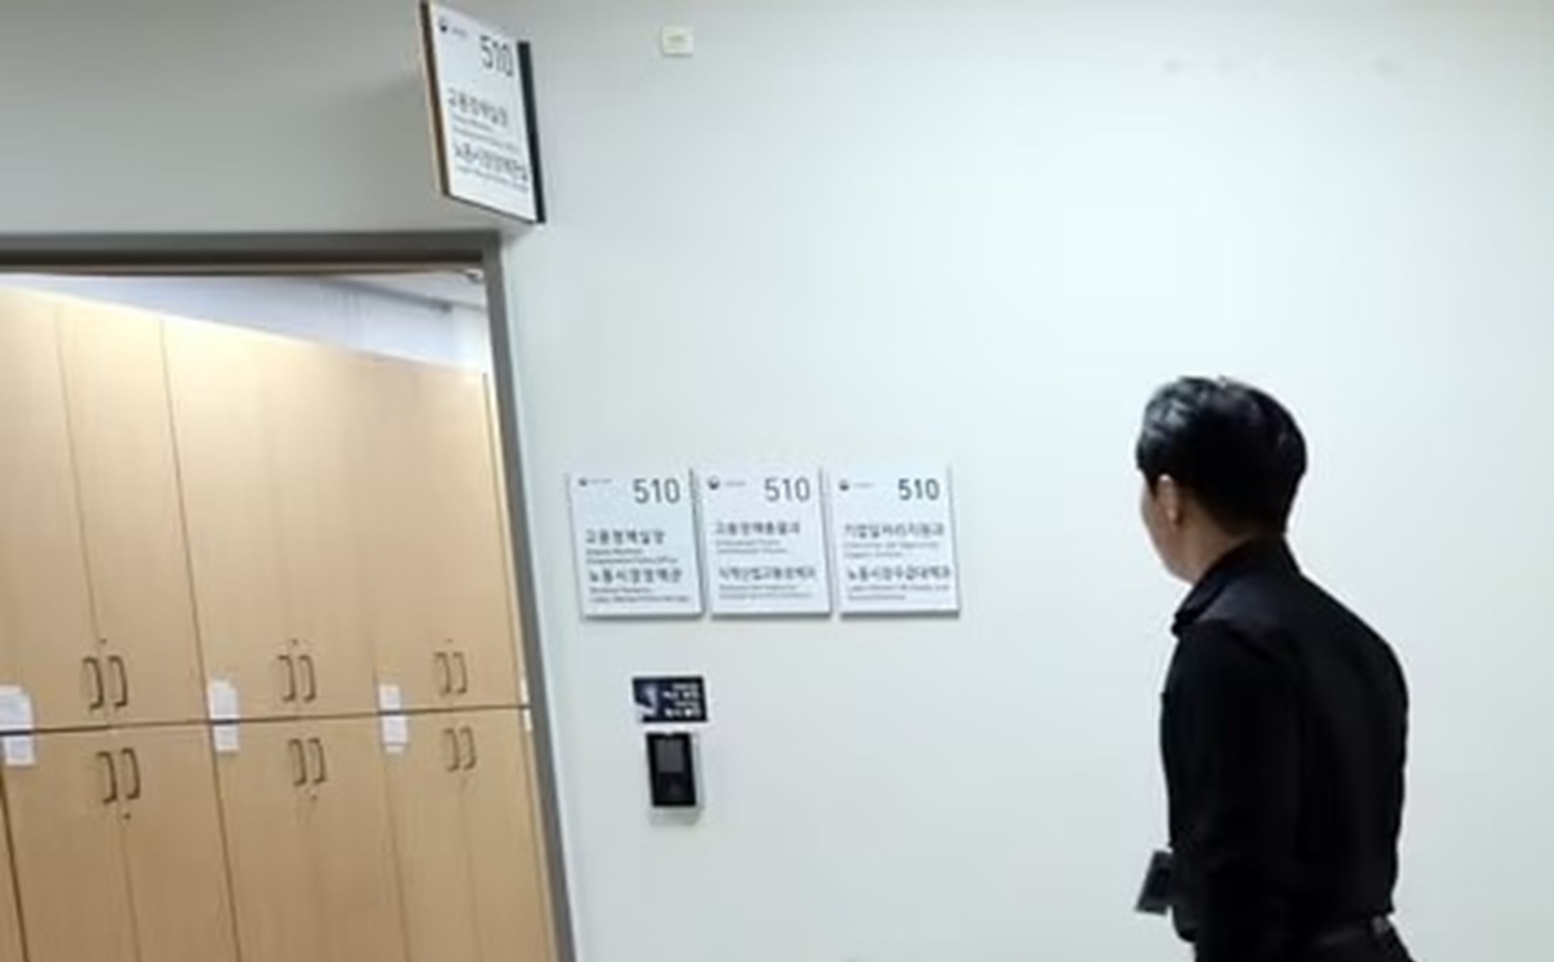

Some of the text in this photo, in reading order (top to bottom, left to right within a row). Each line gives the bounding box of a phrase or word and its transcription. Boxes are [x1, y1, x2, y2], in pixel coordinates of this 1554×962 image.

[480, 34, 514, 77] 510
[633, 478, 681, 504] 510
[764, 477, 811, 502] 510
[898, 478, 941, 501] 510
